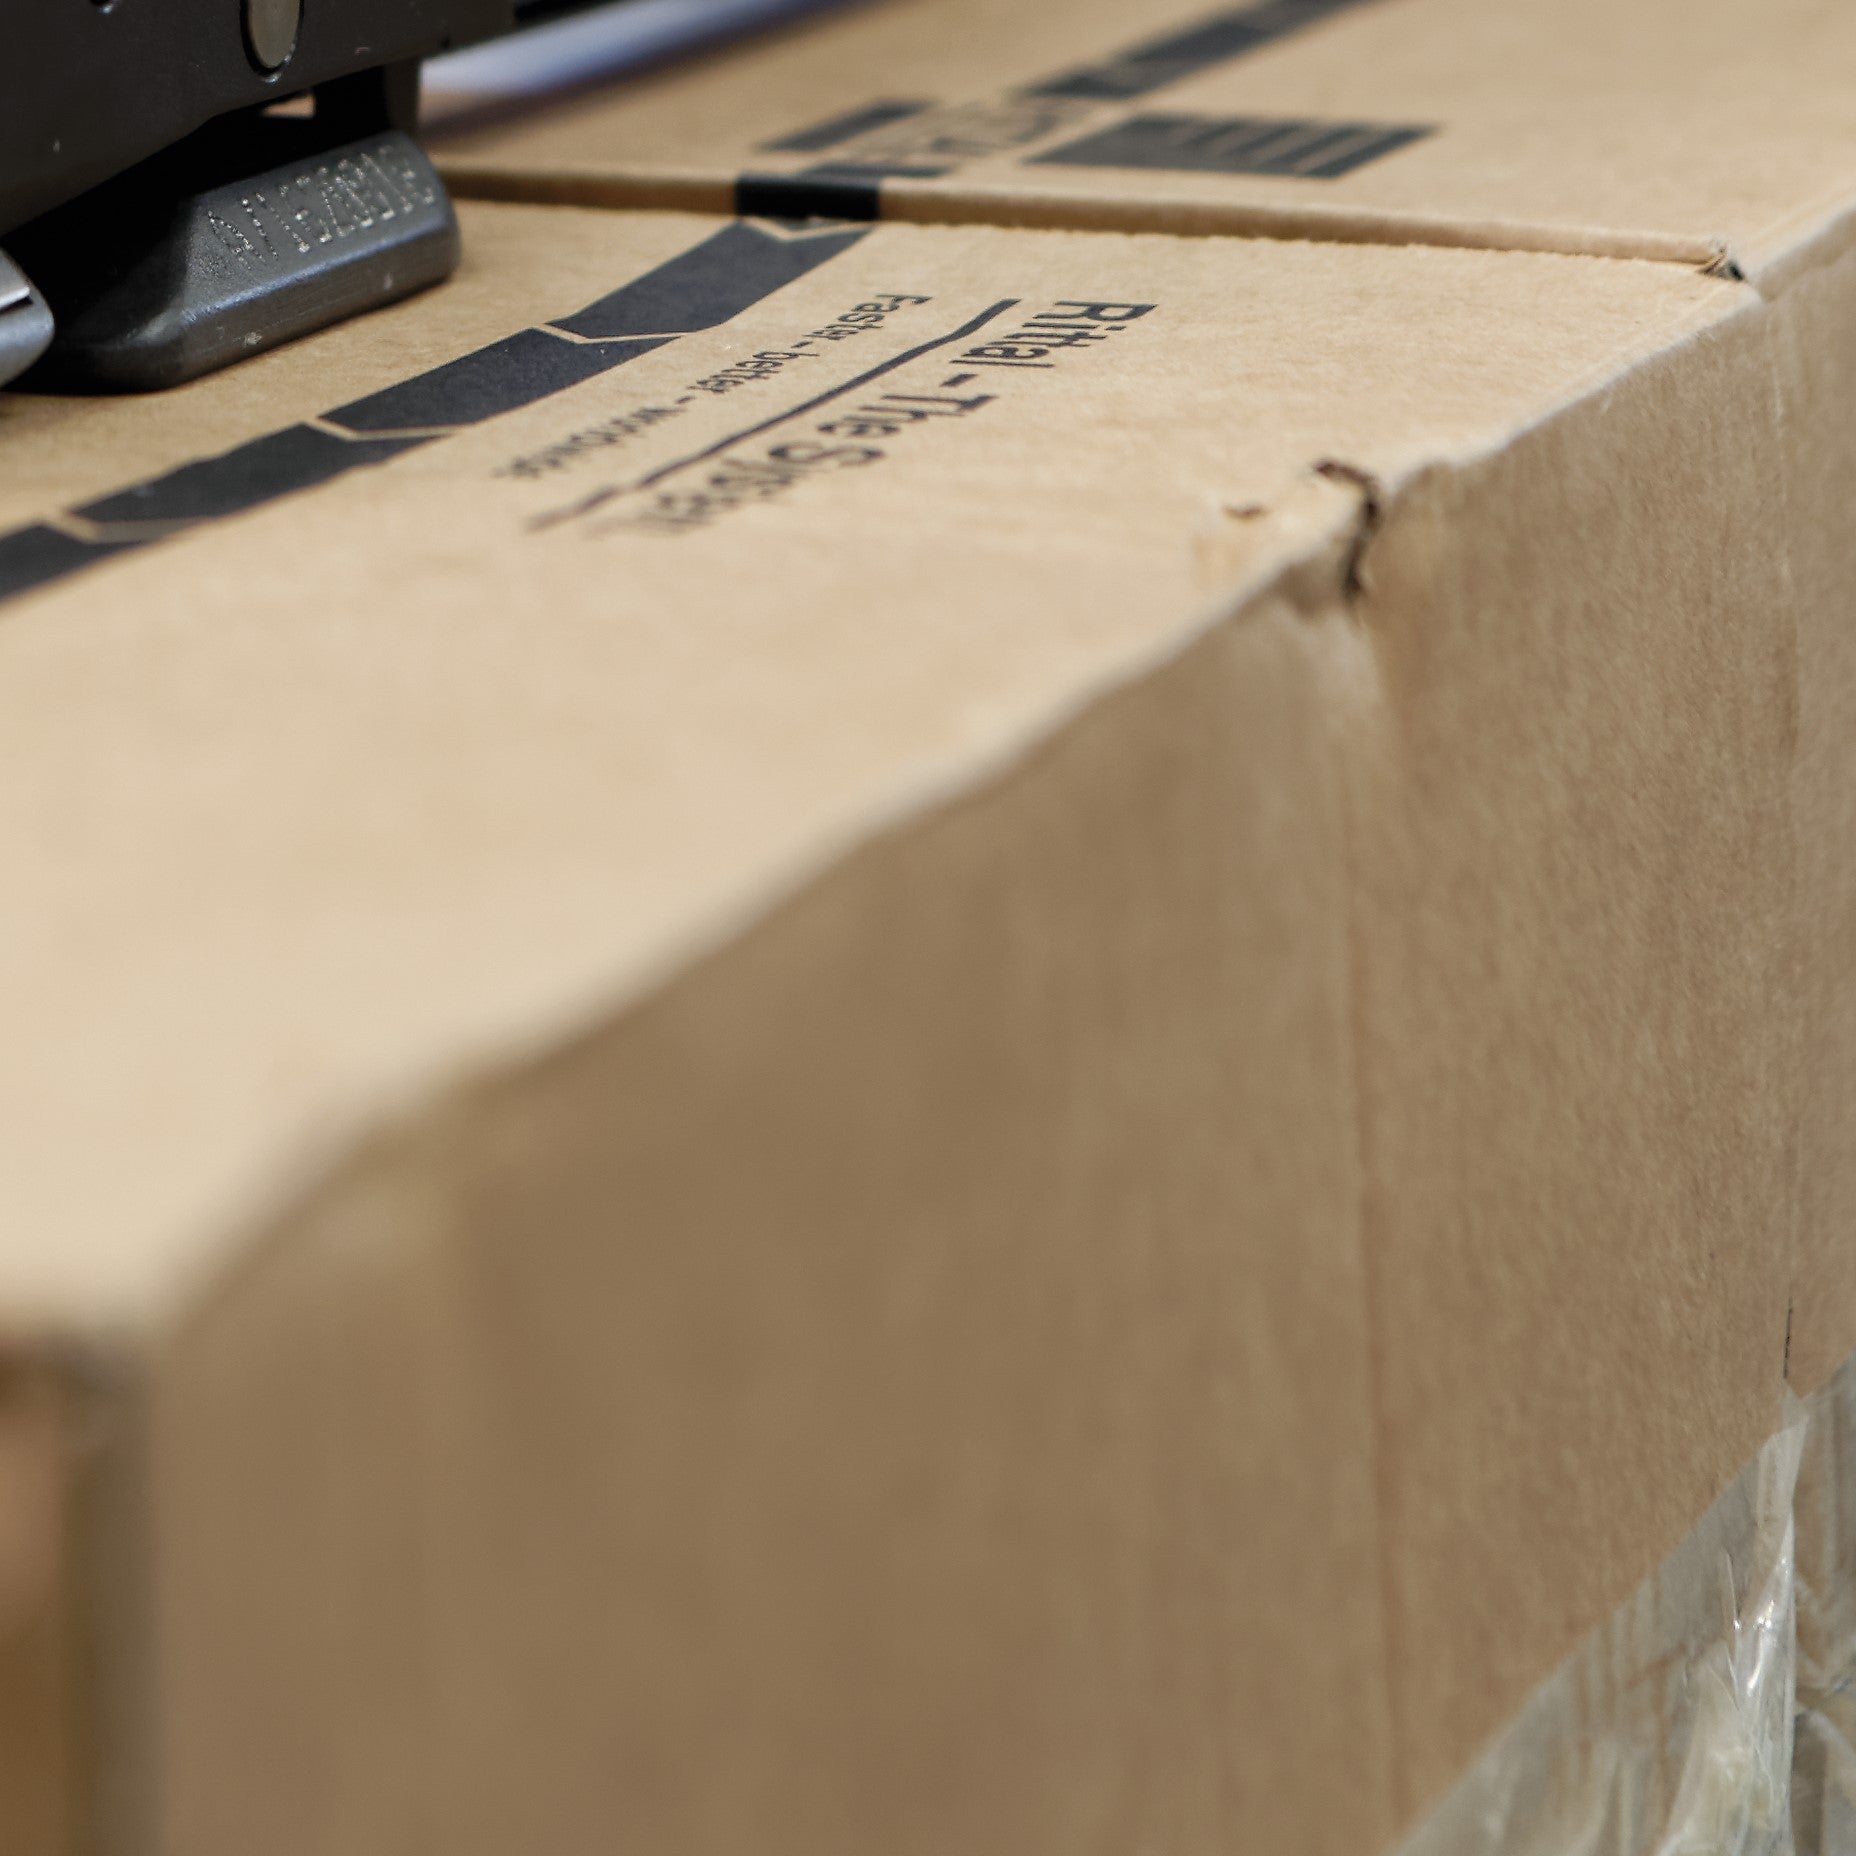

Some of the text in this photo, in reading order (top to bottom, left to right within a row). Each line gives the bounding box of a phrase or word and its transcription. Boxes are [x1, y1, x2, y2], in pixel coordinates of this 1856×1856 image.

[819, 293, 933, 342] Faster
[950, 300, 1158, 369] Rittal
[688, 350, 820, 394] better
[818, 394, 998, 438] The
